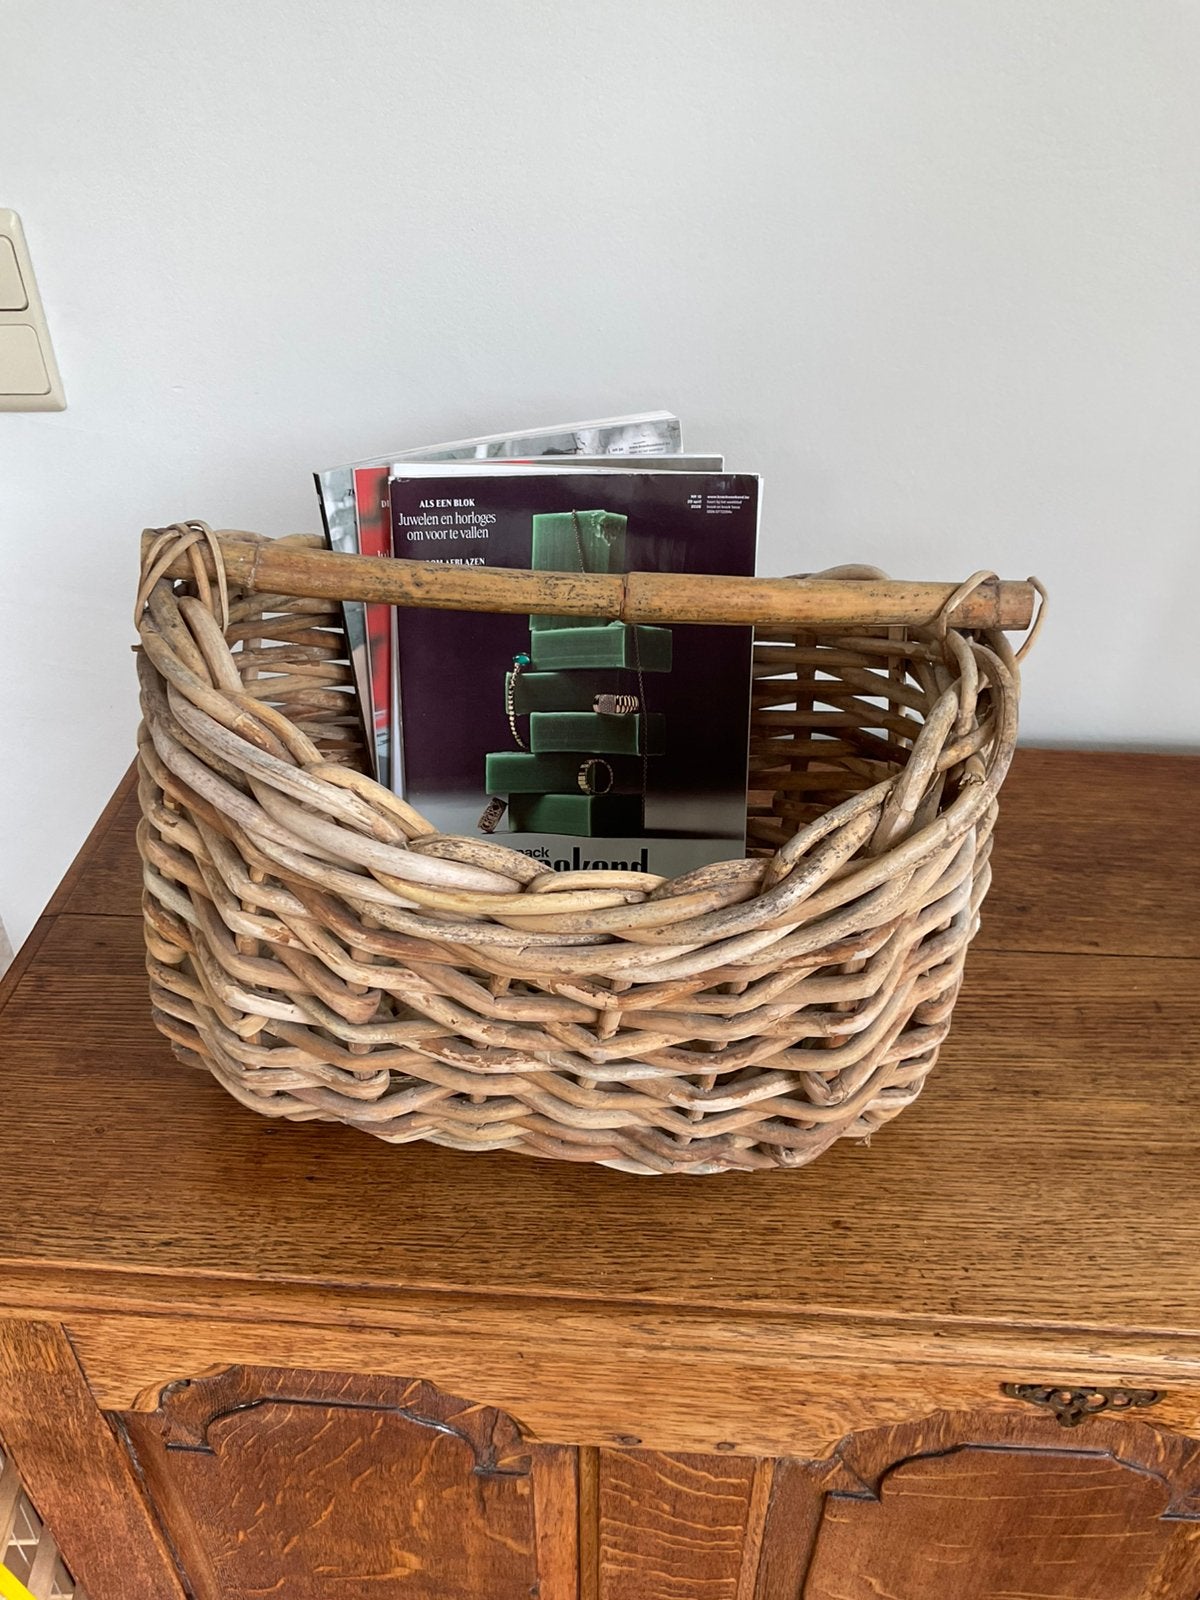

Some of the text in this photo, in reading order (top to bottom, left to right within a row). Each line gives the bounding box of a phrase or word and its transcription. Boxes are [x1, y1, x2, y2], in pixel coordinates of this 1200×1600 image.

[419, 498, 475, 508] ALS EEN BLOK
[398, 511, 497, 527] Juwelen en horloges
[406, 525, 489, 541] om voor te vallen
